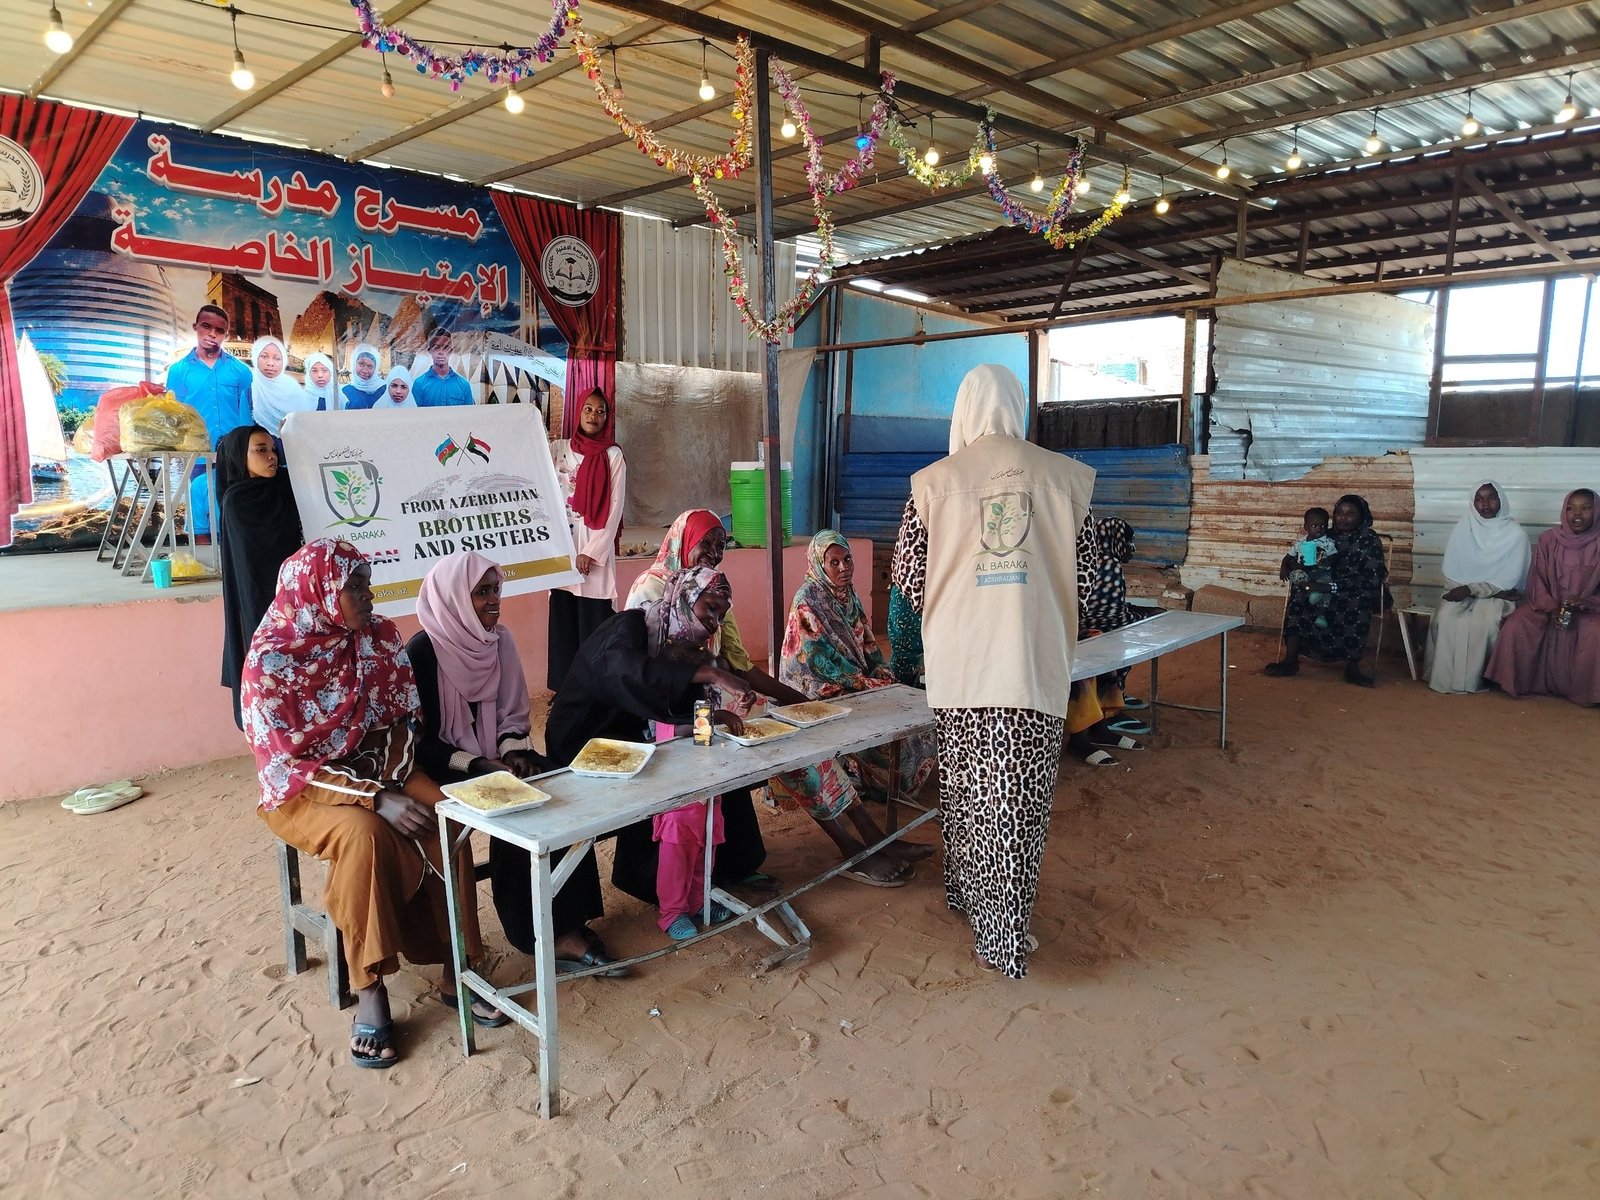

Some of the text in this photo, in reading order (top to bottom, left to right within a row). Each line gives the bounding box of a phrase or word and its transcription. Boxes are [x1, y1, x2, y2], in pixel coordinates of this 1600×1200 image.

[0, 150, 21, 165] مدرس
[148, 134, 483, 241] مسرح مدرسة
[573, 246, 589, 261] مدرسة
[111, 207, 508, 317] الإمتياز الخاصة
[400, 488, 539, 514] FROM AZERBAIJAN
[418, 508, 532, 538] BROTHERS
[350, 529, 386, 541] BARAKA
[414, 525, 550, 560] AND SISTERS
[503, 569, 516, 577] 026
[976, 560, 1028, 571] AL BARAKA
[374, 587, 408, 598] raka_az
